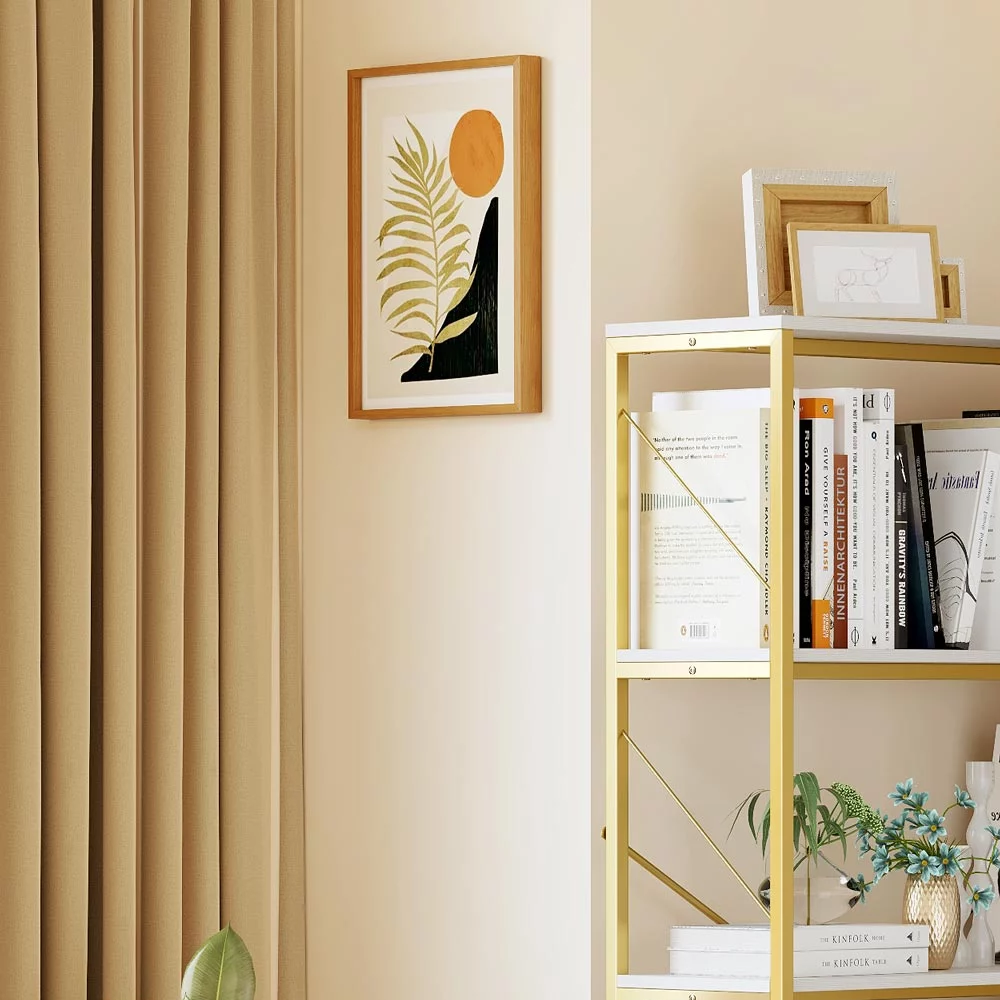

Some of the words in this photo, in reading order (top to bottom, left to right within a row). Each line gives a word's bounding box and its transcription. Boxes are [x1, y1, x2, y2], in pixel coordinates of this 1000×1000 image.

[836, 466, 845, 620] INNENARCHITEKTUR
[898, 529, 907, 578] GRAVITY'S
[898, 581, 907, 627] RAINBOW
[832, 934, 869, 943] KINFOLK
[834, 958, 870, 968] KINFOLK
